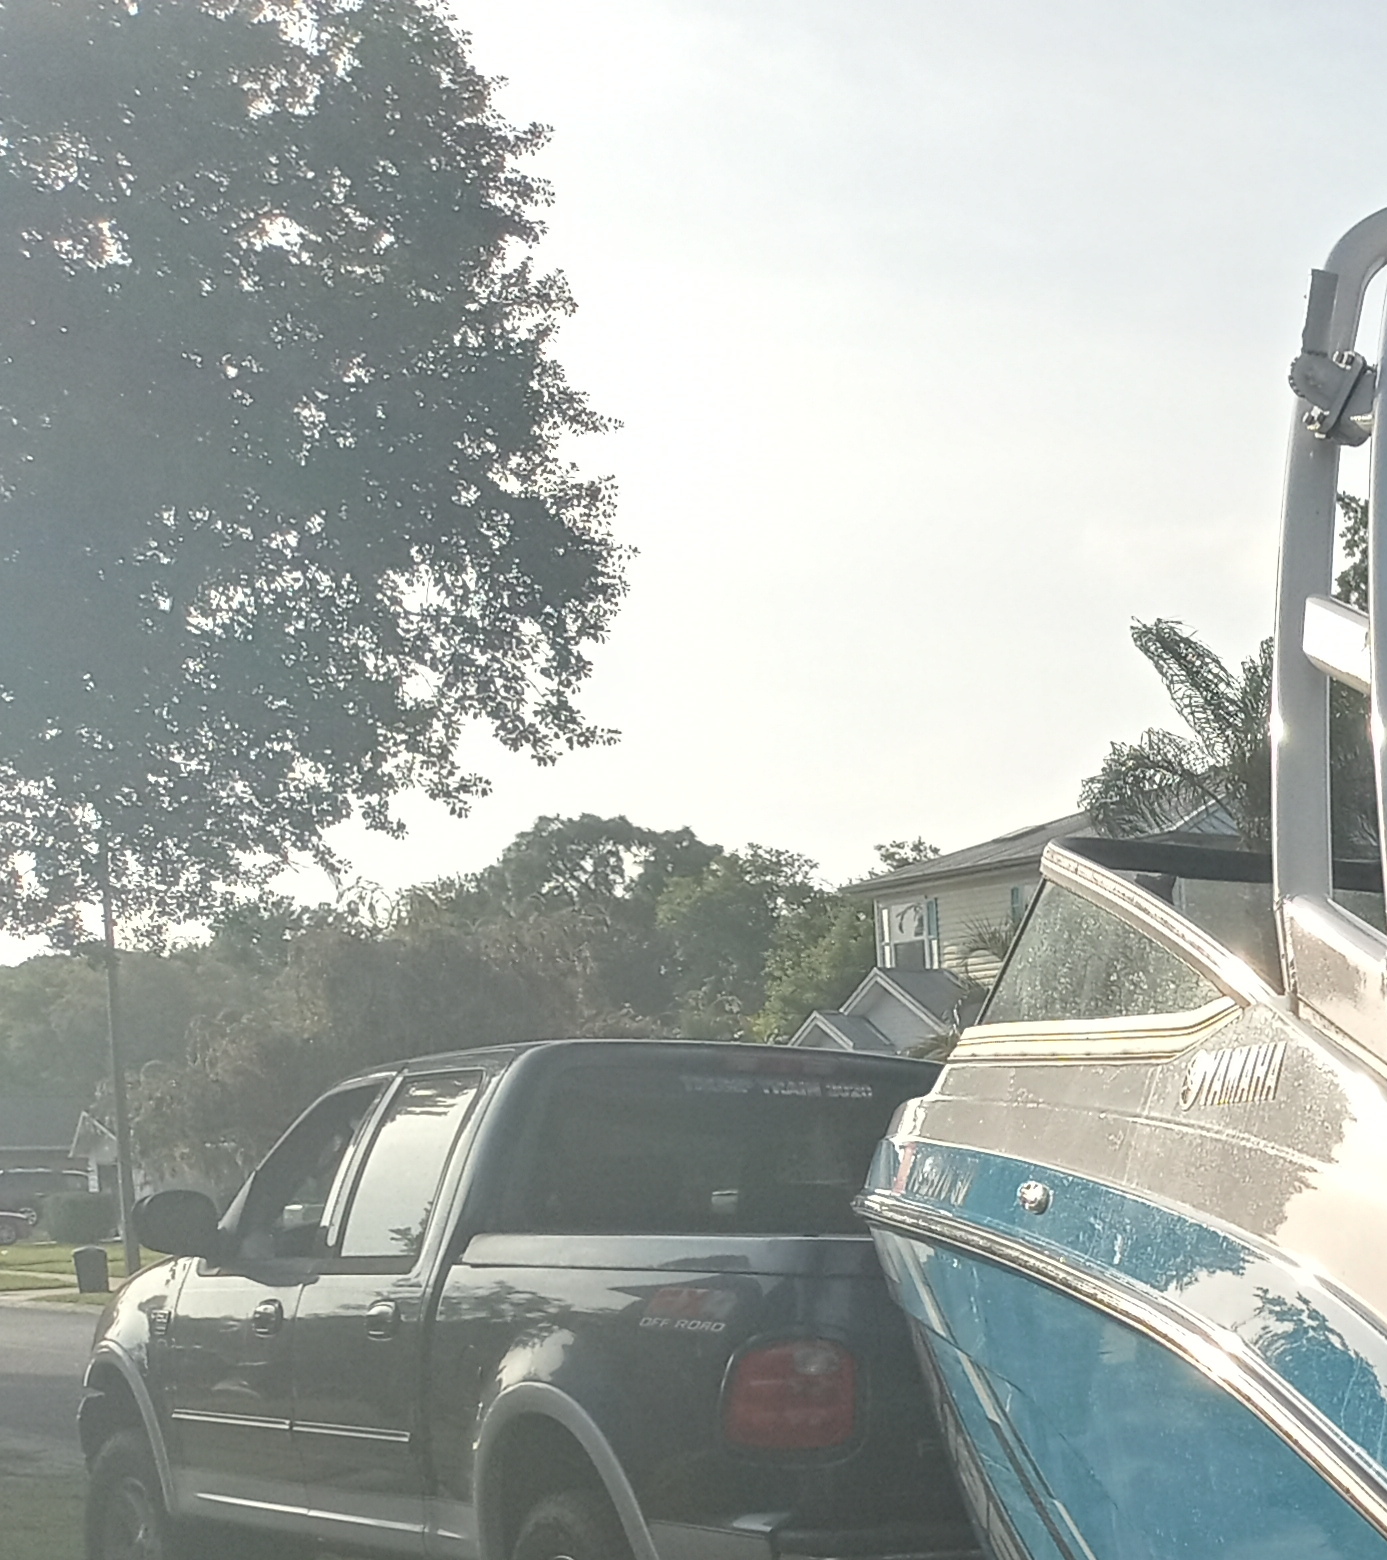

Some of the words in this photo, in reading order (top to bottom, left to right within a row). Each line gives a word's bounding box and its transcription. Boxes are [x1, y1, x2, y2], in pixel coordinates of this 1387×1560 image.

[1199, 1041, 1287, 1106] YAMAHA
[639, 1316, 669, 1327] OFF
[674, 1319, 726, 1332] ROAD
